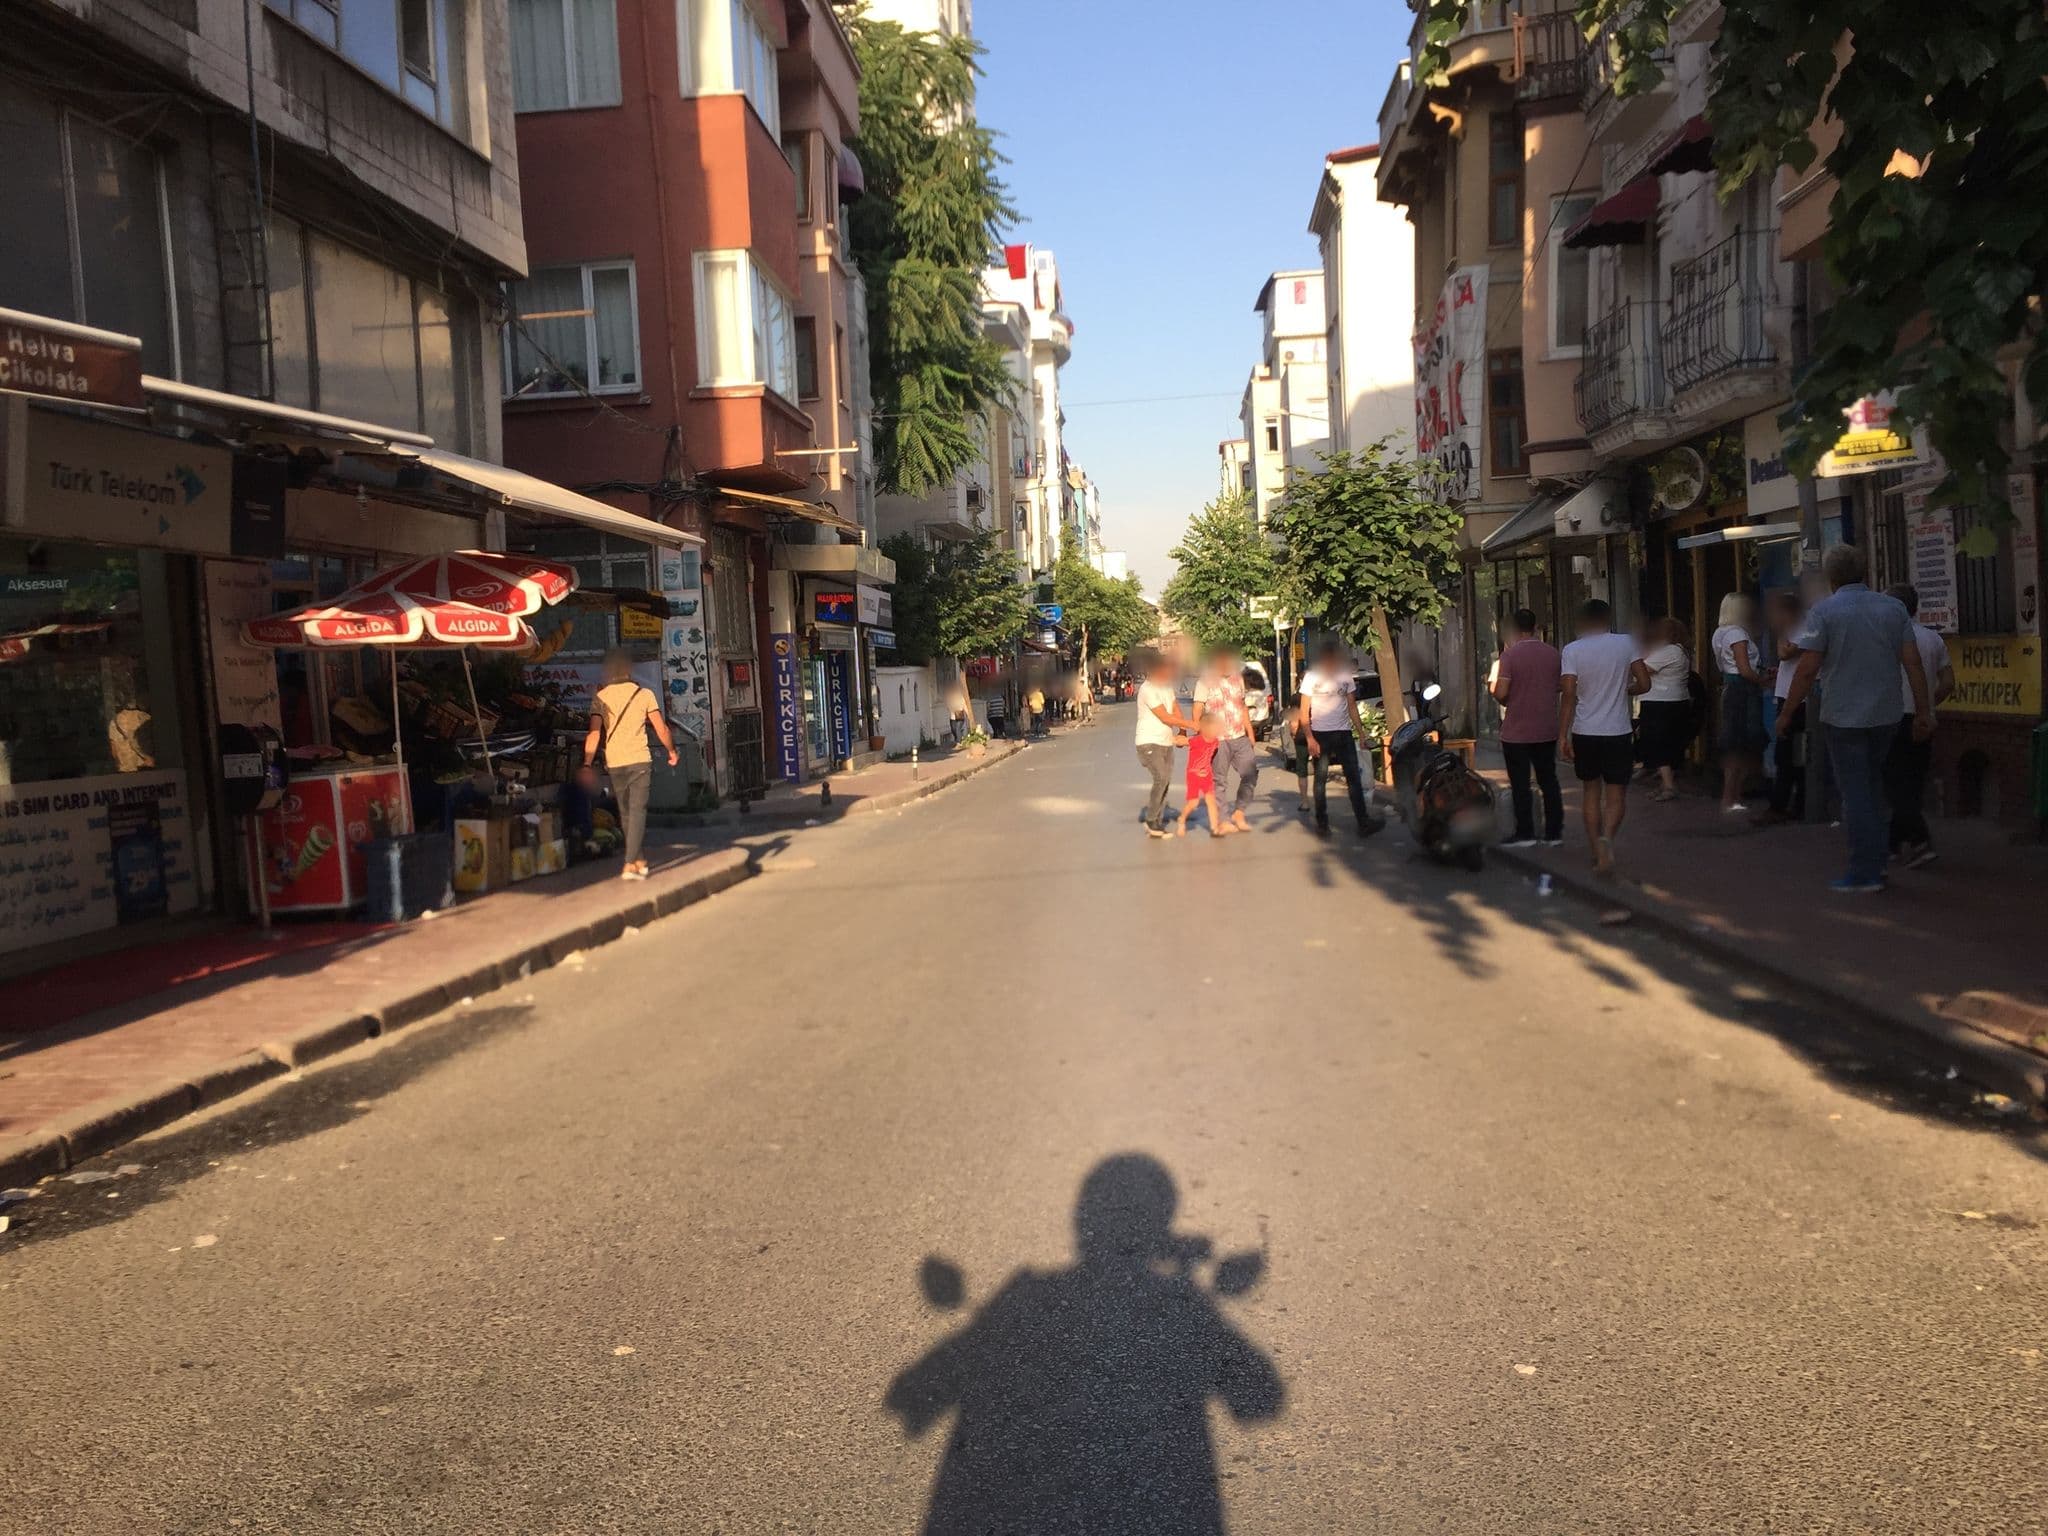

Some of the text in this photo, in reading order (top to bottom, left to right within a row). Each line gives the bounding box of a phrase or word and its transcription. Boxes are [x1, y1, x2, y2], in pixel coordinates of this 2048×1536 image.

[50, 462, 176, 505] Türk Telekom
[8, 578, 69, 591] Aksesuar
[448, 619, 498, 633] ALGIDA
[1962, 645, 2009, 669] HOTEL
[777, 658, 796, 777] TURKCELL
[830, 652, 845, 755] TURKCELL
[23, 796, 50, 816] SIM
[53, 792, 90, 811] CARD
[94, 788, 120, 805] AND
[123, 782, 178, 801] INTERNET
